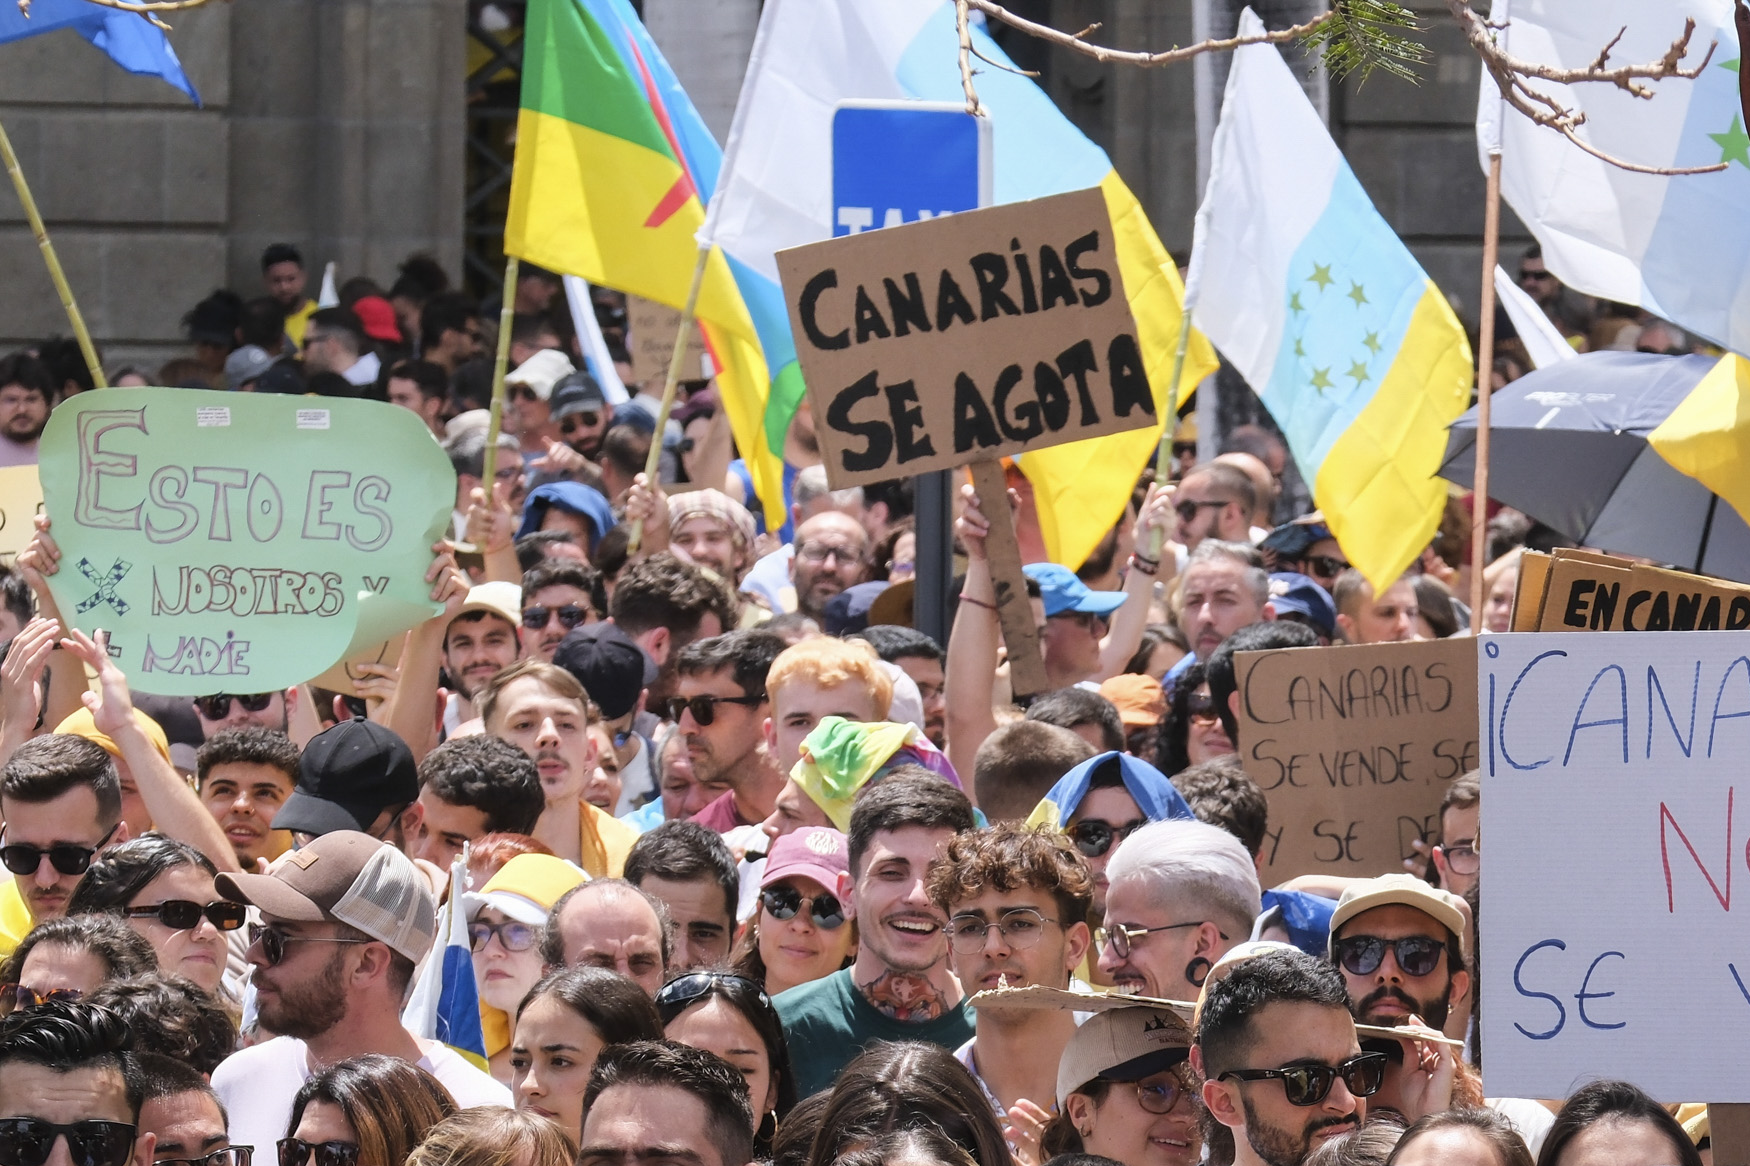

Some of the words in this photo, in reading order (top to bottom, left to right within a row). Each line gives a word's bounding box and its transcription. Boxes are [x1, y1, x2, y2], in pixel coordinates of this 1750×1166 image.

[799, 230, 1111, 350] CANARIAS
[827, 369, 937, 471] SE
[954, 334, 1156, 454] AGOTA
[74, 404, 283, 544] ESTO
[301, 471, 393, 552] ES
[152, 564, 345, 617] NOSOTROS
[1563, 579, 1620, 631] EN
[142, 630, 250, 676] NADIE
[1245, 652, 1453, 725] CANARIAS
[1252, 739, 1310, 791] SE
[1313, 819, 1365, 863] SE
[1512, 938, 1628, 1040] SE
